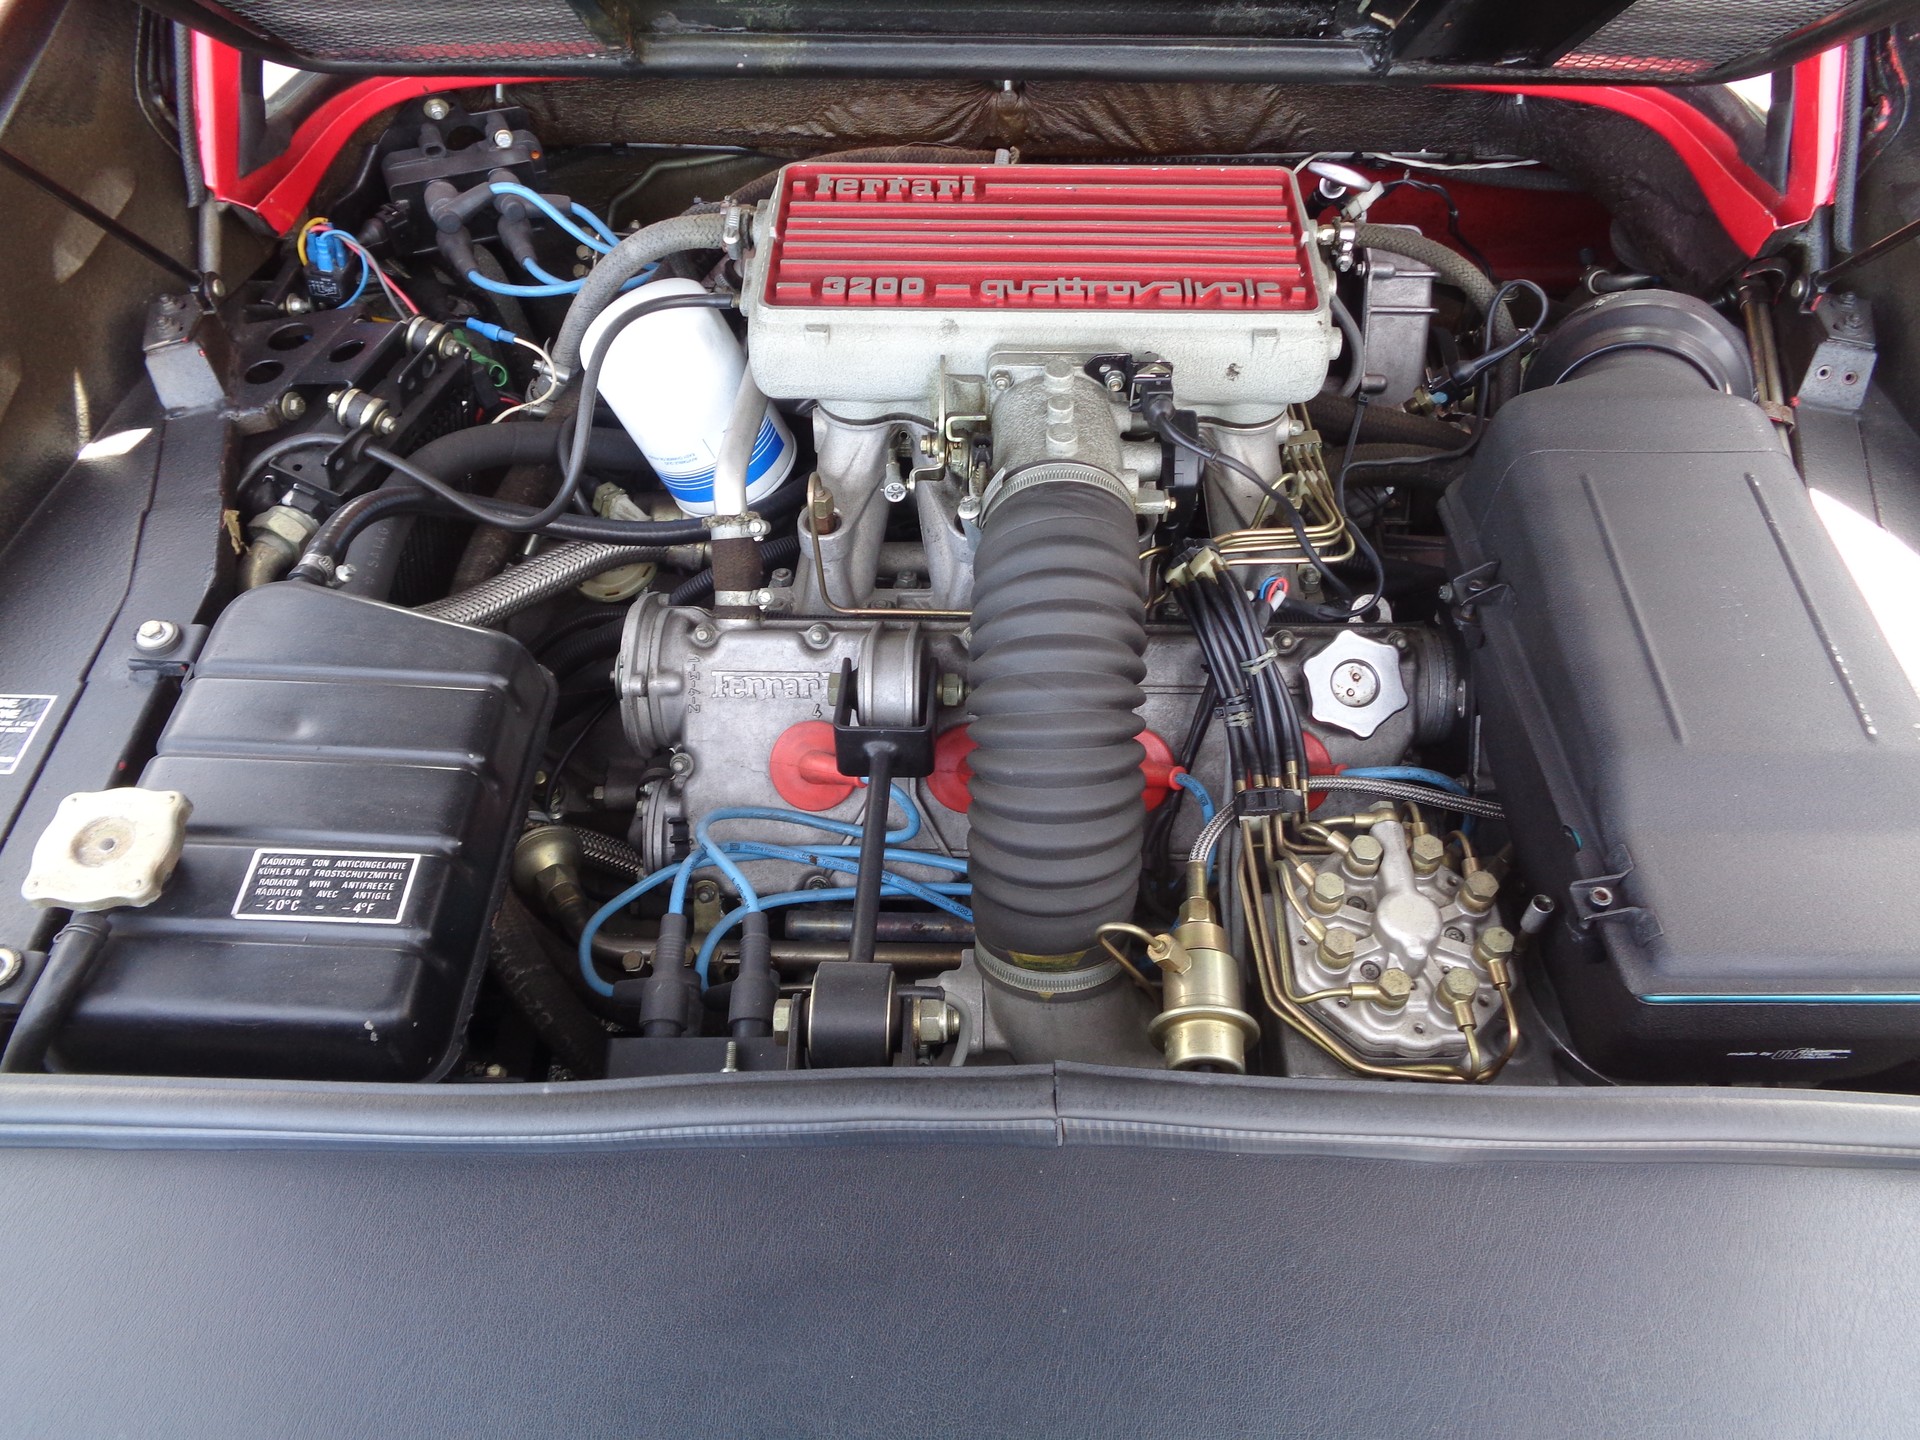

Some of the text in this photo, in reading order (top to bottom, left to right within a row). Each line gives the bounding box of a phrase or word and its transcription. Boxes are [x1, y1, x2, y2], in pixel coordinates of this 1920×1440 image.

[821, 276, 1282, 300] 3200 quattrovalvole
[812, 703, 823, 719] 4
[261, 857, 408, 870] RADIATORE CON ANTICONGELANTE
[294, 868, 311, 877] MIT
[313, 869, 403, 880] FROSTSCHUTZMITTEL
[258, 878, 395, 891] RADIATOR WITH ANTIFREEZE
[255, 888, 392, 900] RADIATEUR AVEC ANTIGEL
